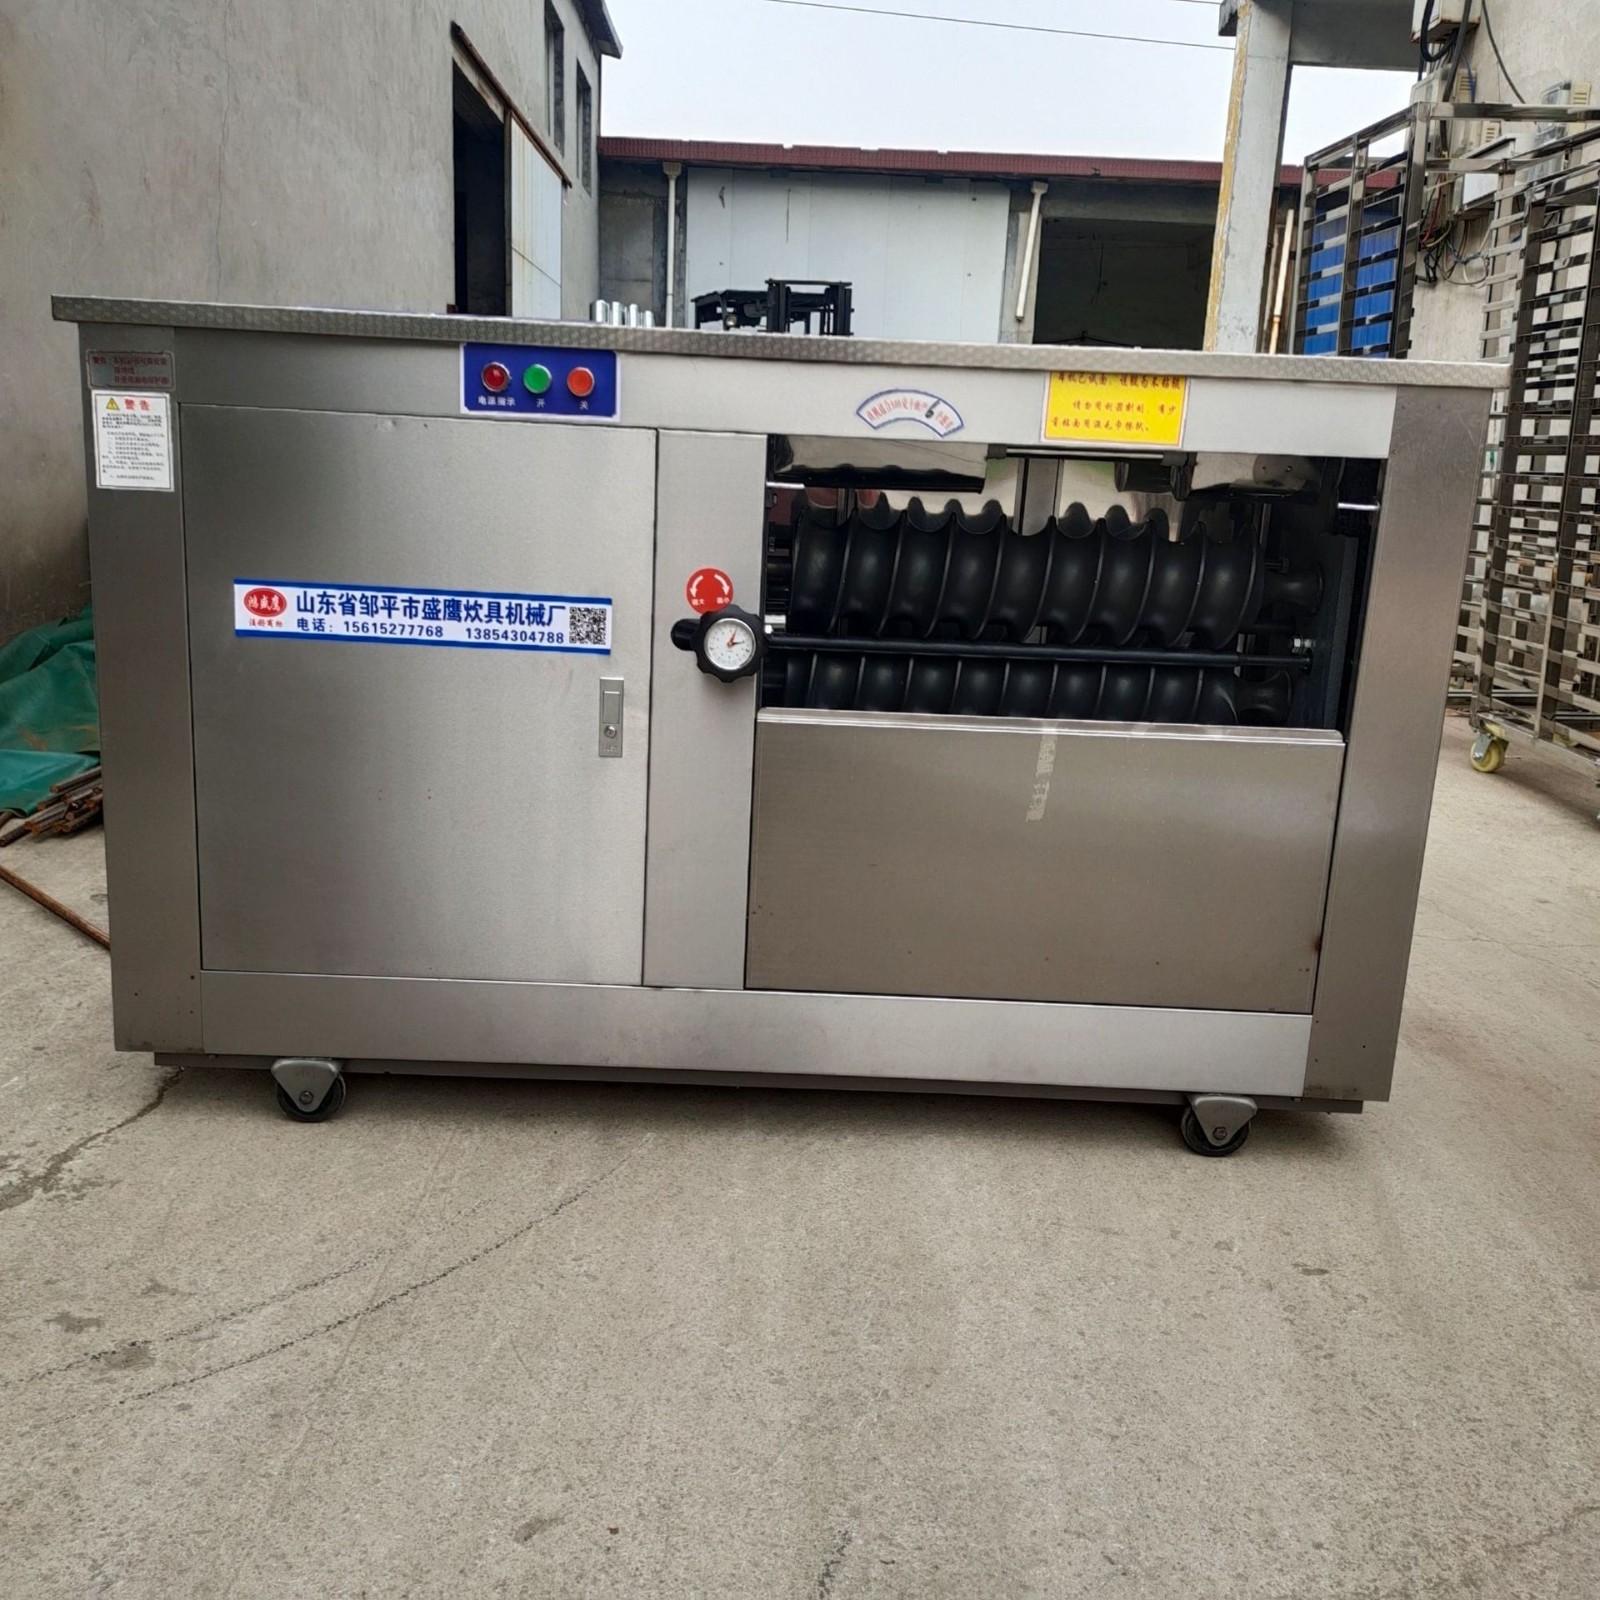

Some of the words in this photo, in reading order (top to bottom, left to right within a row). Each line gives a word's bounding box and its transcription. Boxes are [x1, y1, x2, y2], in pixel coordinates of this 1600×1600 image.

[124, 398, 150, 411] 警告
[477, 395, 516, 407] 电源指示
[536, 398, 546, 408] 开
[579, 400, 589, 410] 关
[296, 590, 567, 627] 山东省邹平市盛鹰炊具机械厂
[343, 620, 443, 639] 15615277768
[465, 627, 565, 644] 13854304788
